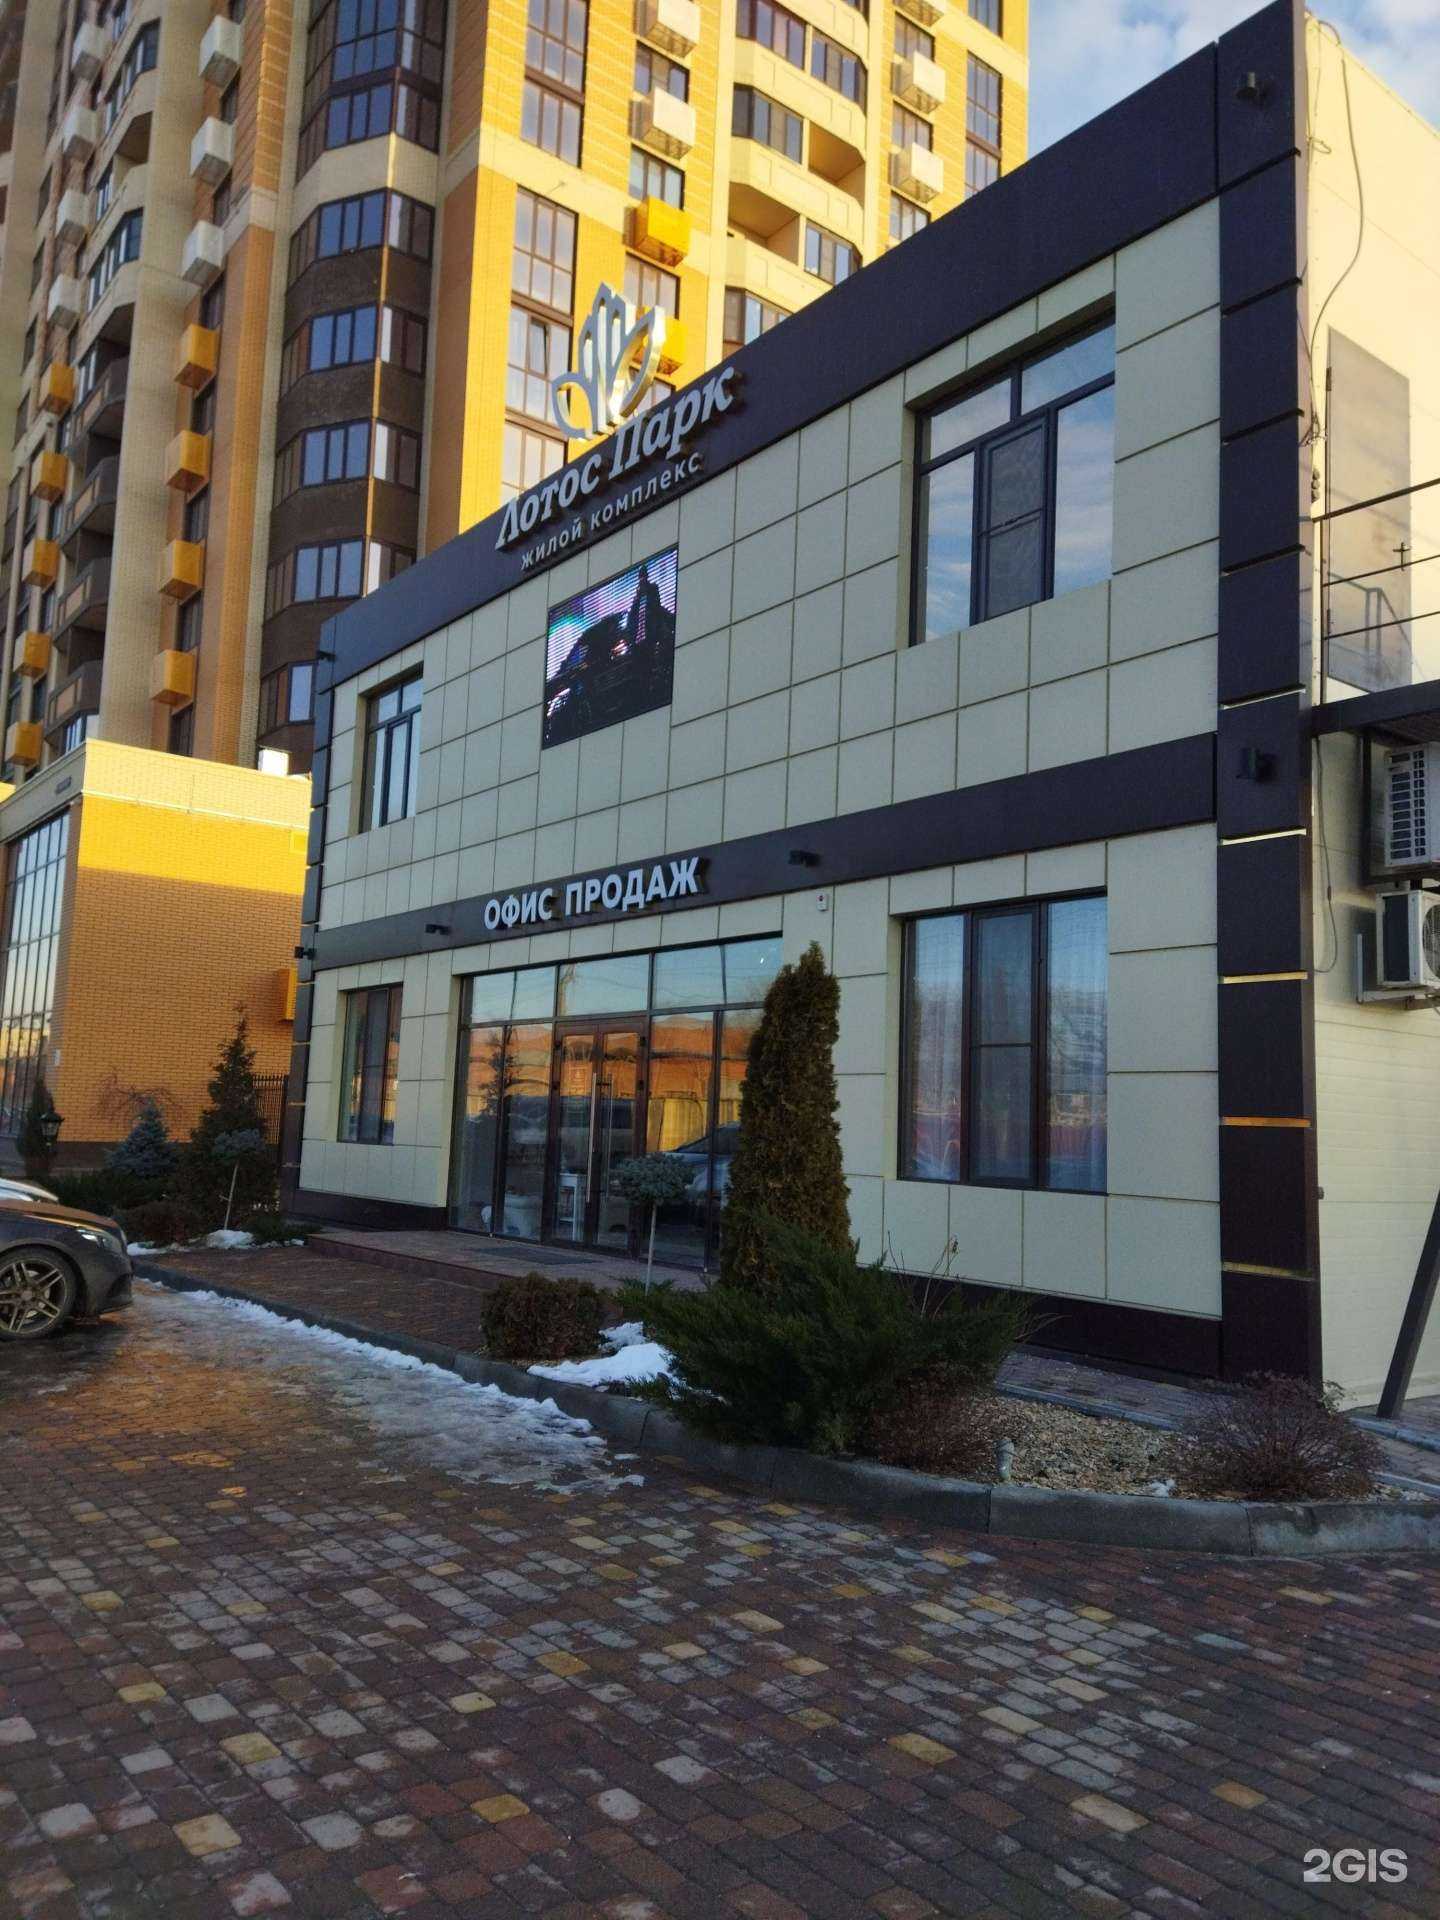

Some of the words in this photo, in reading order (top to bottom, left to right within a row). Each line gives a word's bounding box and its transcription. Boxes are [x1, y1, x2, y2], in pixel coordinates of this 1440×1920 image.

[495, 453, 601, 549] Лотос
[608, 366, 735, 480] Парк
[521, 519, 582, 571] жилой
[590, 452, 700, 531] комплекс
[484, 887, 553, 930] ОФИС
[564, 857, 699, 916] ПРОДАЖ
